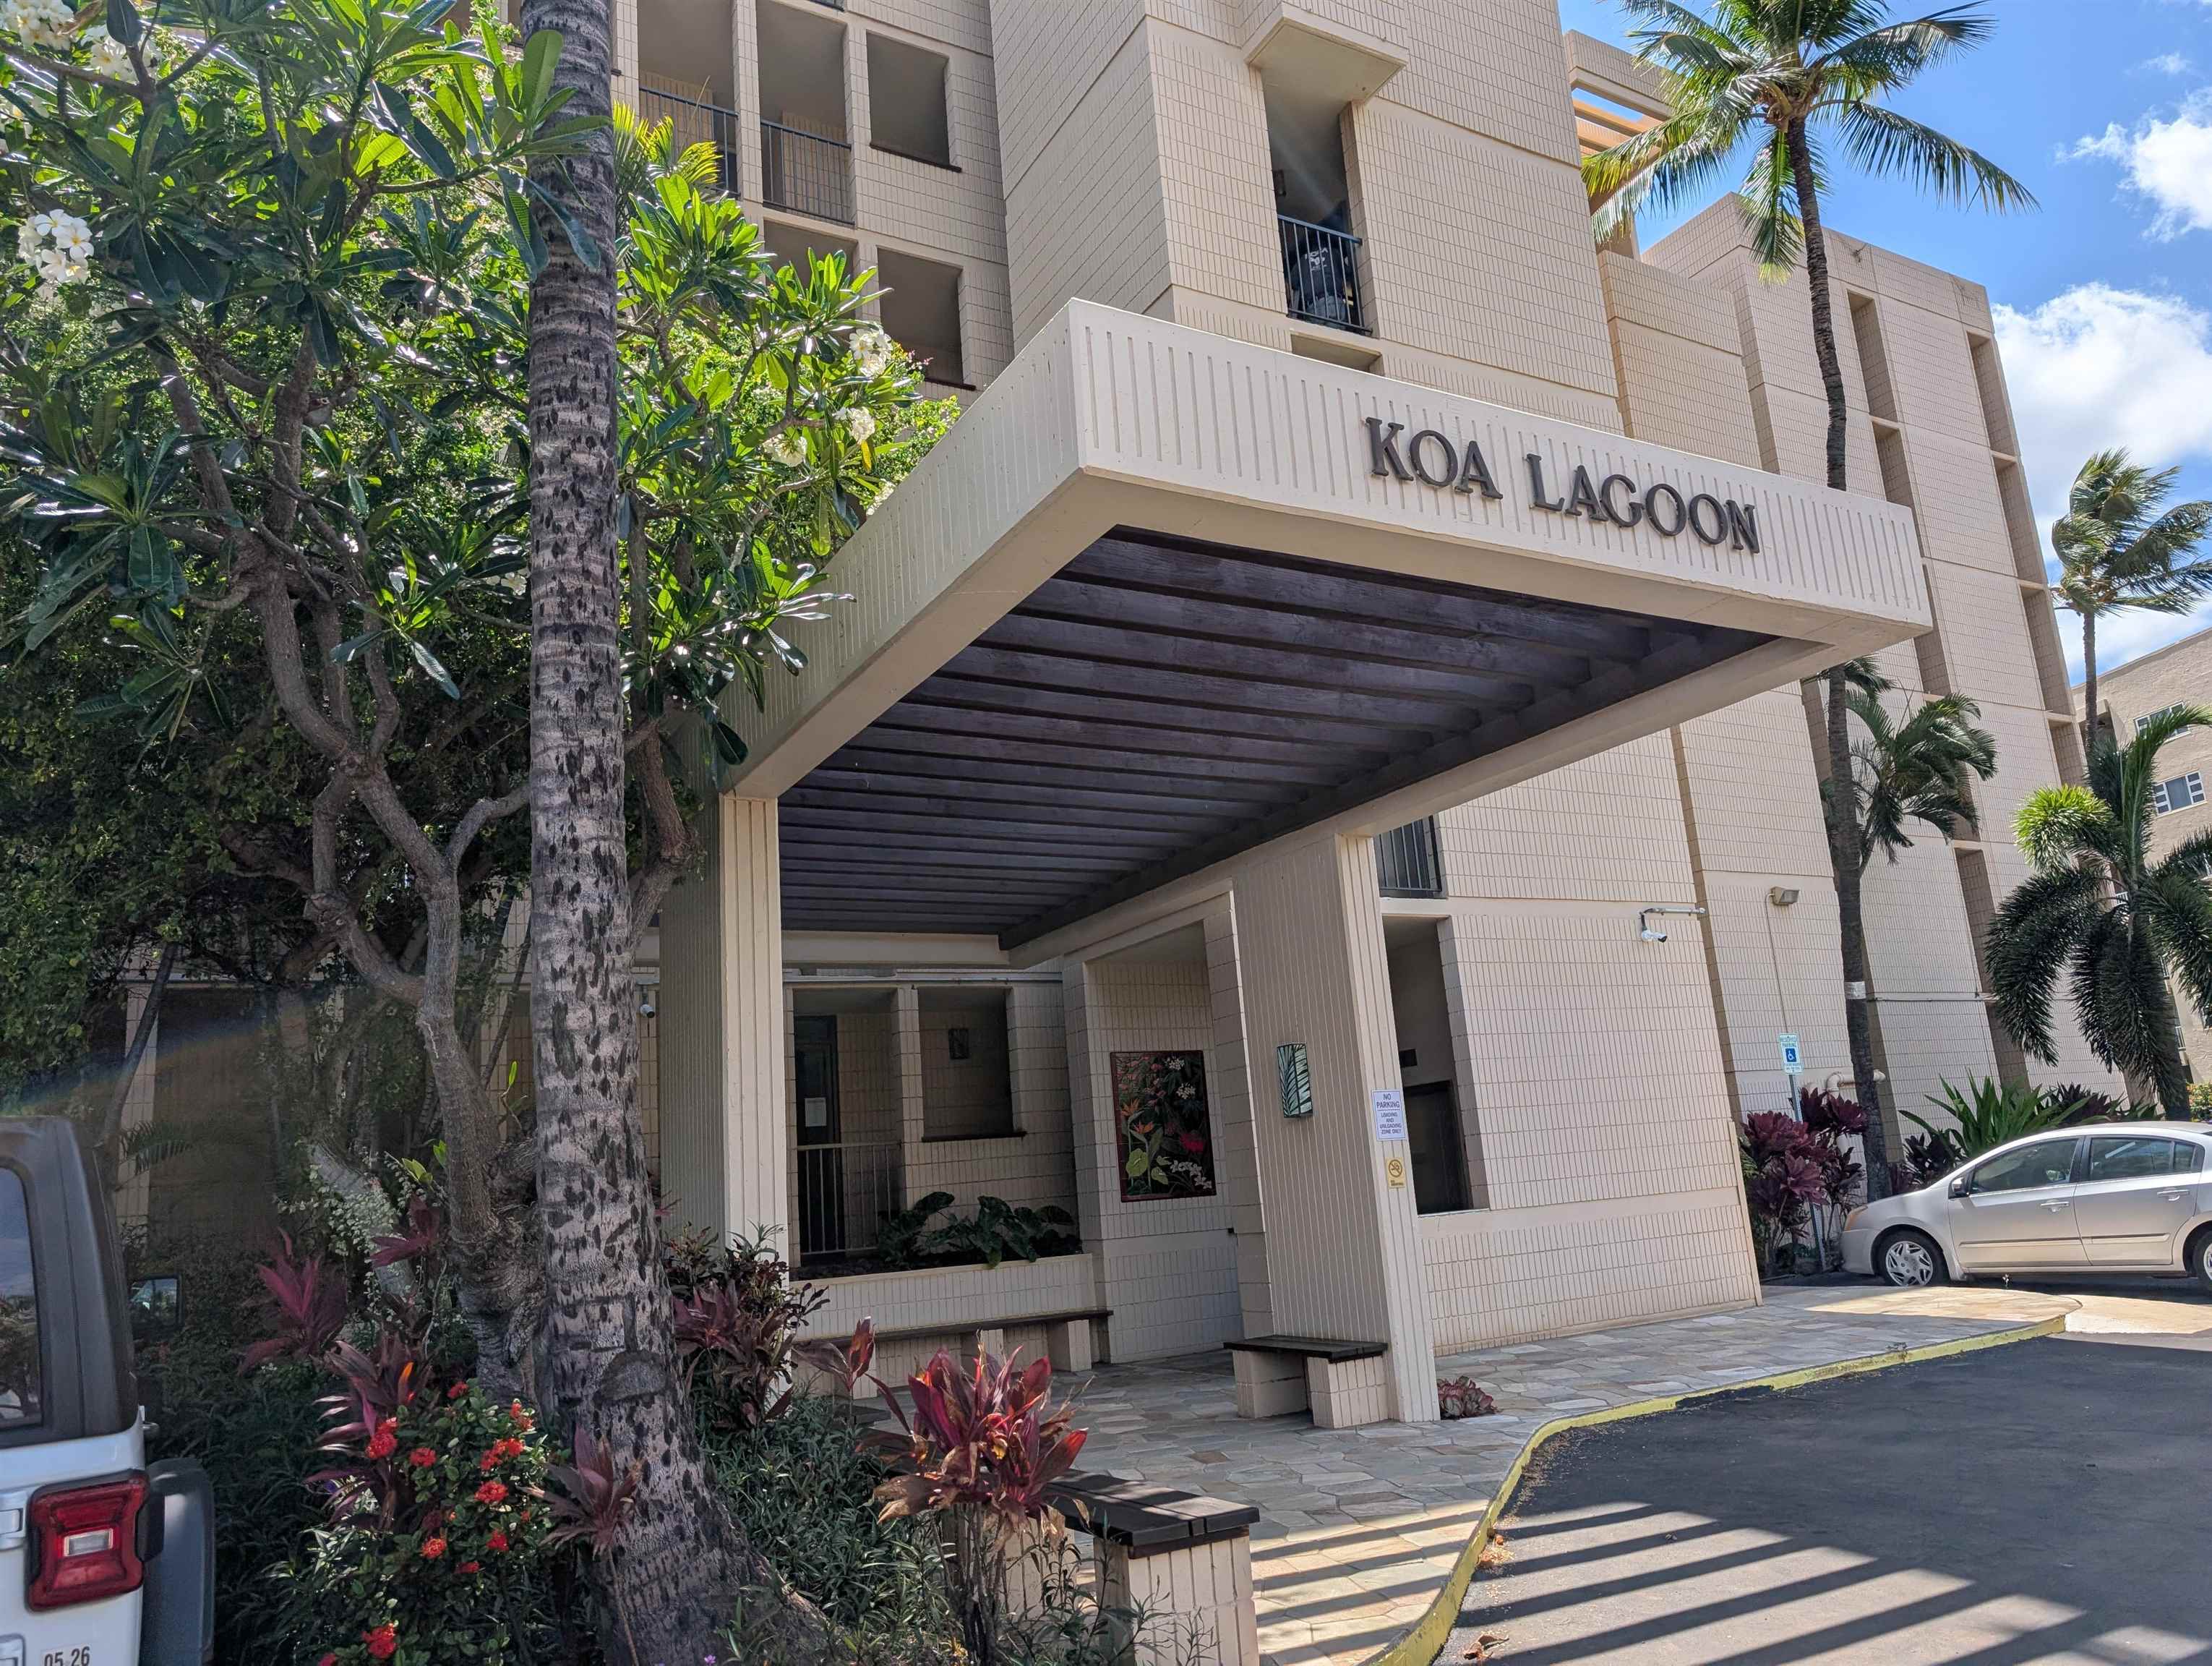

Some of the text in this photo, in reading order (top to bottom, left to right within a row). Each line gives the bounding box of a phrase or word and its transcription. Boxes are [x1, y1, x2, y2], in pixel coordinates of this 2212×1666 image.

[1365, 417, 1761, 554] KOA LAGOON
[71, 1646, 90, 1666] 26
